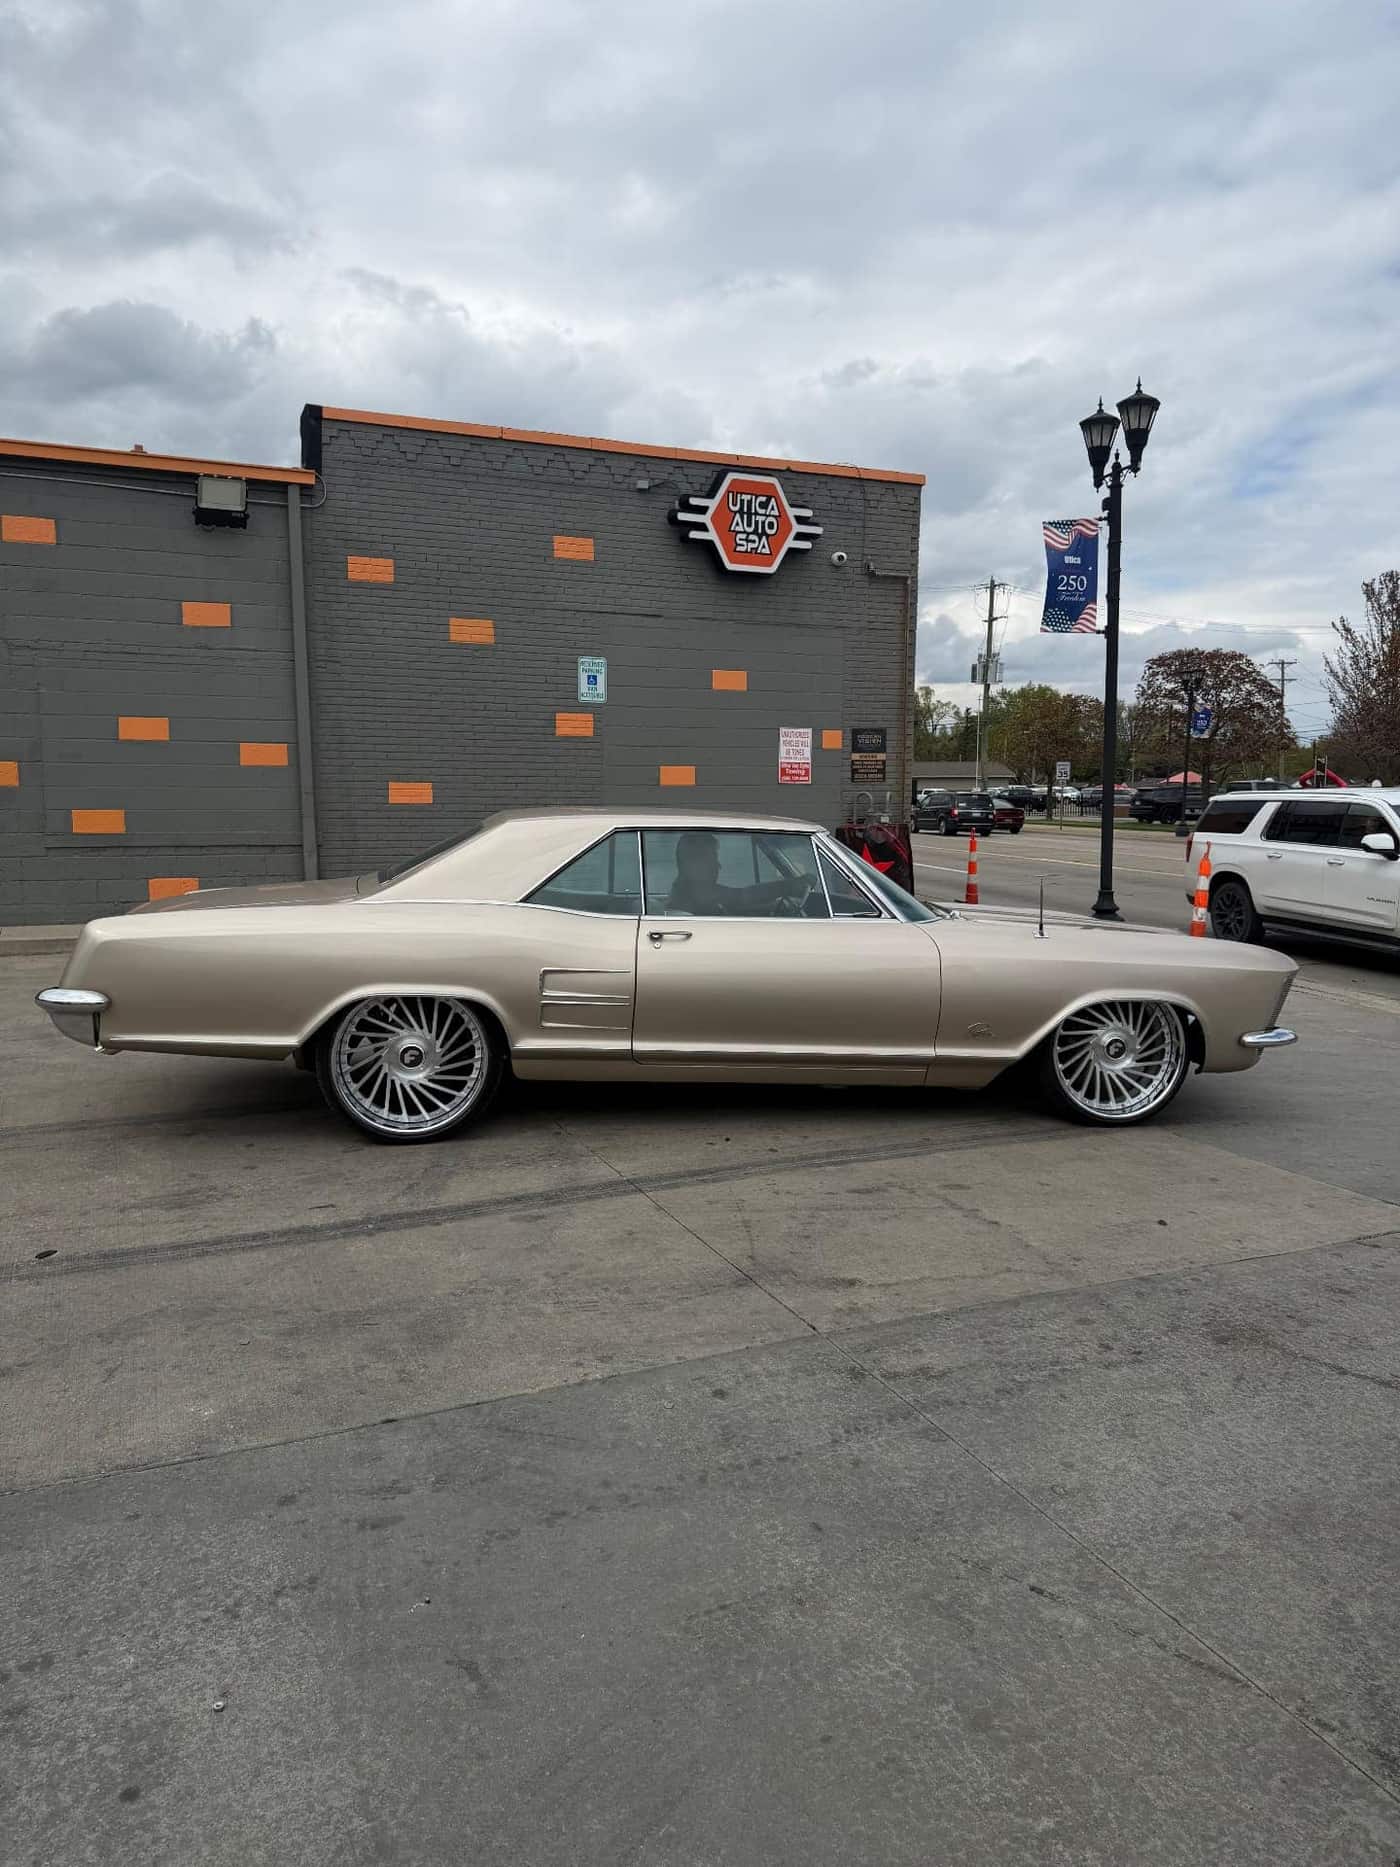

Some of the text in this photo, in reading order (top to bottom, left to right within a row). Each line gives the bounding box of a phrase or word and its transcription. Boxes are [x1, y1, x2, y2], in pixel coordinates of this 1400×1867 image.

[728, 492, 779, 515] UTICA
[730, 512, 778, 535] AUTO
[735, 533, 771, 554] SPA
[1064, 555, 1081, 564] Utica
[1057, 574, 1087, 591] 250
